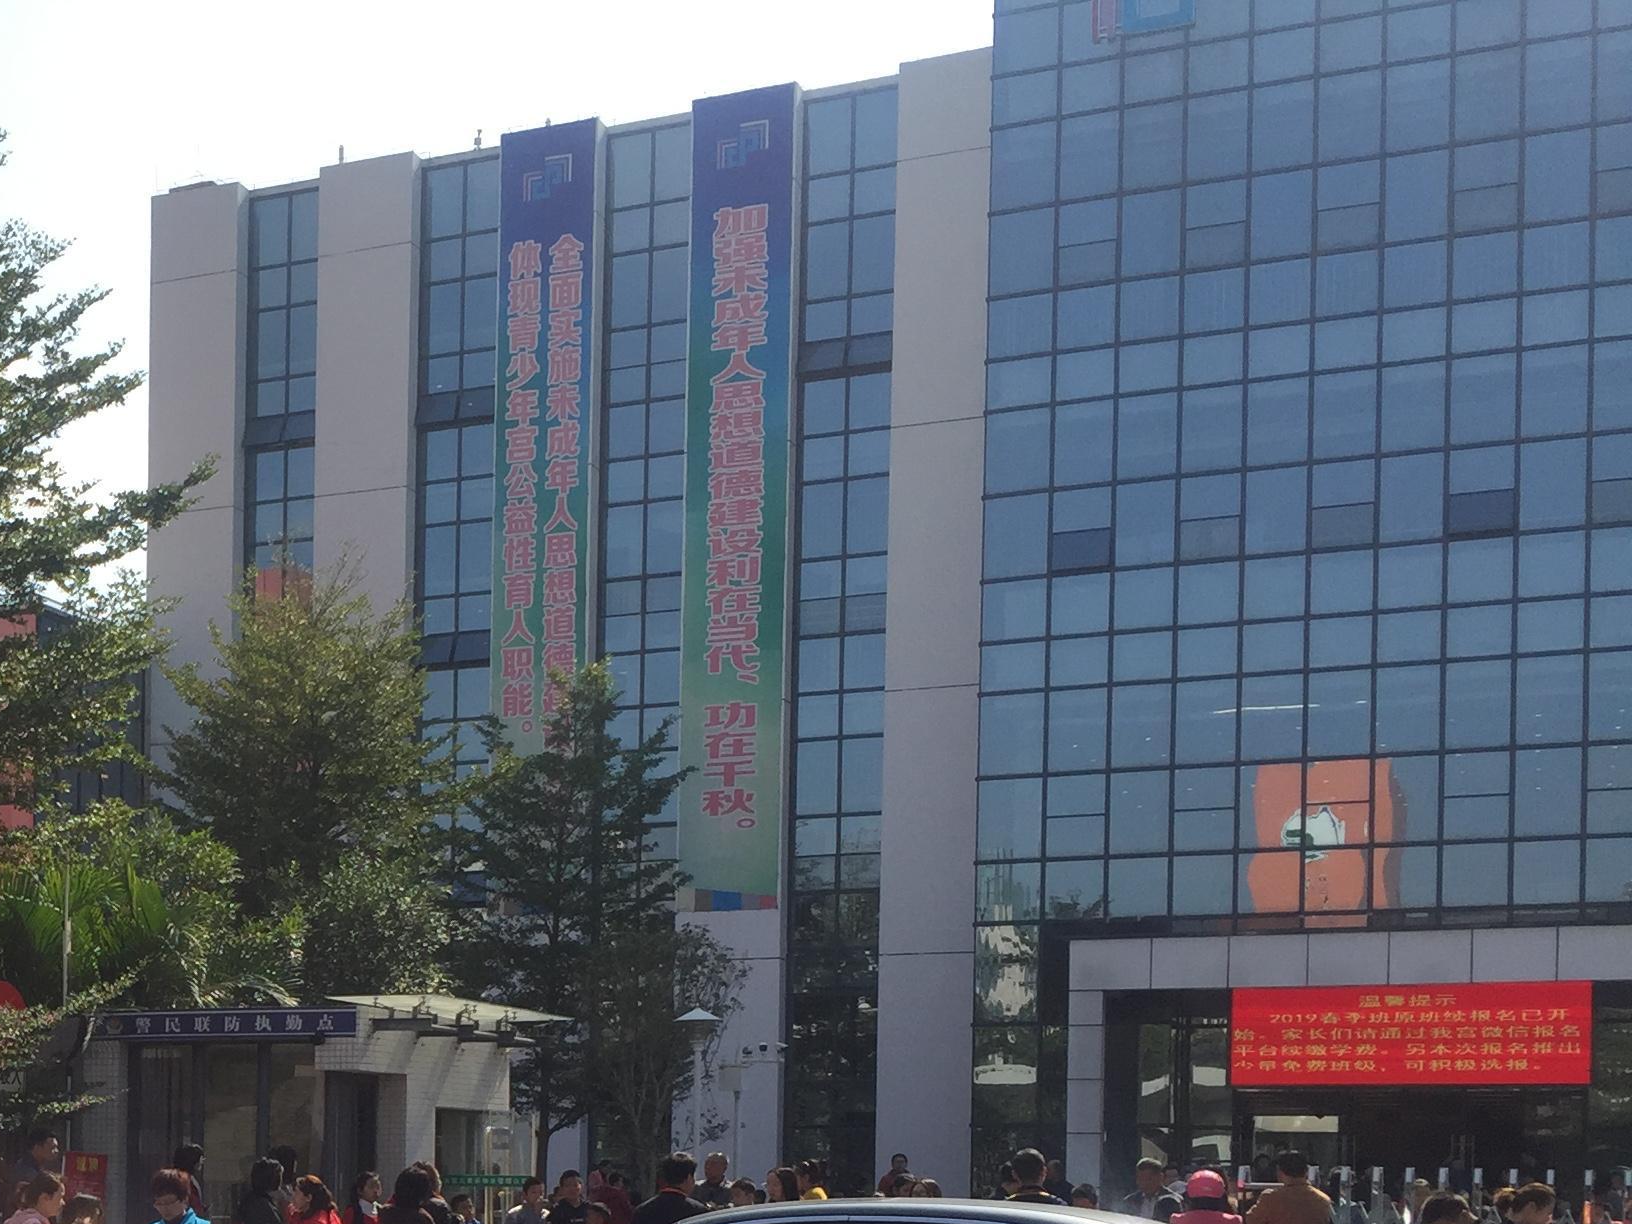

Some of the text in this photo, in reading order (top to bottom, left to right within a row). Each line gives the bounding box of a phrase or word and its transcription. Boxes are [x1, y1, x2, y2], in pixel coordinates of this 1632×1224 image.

[501, 240, 543, 734] 体现青少年宫公益性育人职能。
[542, 233, 585, 748] 全面实施未成年人思想道德建
[135, 1013, 336, 1034] 警民联防执勤点
[1358, 994, 1457, 1008] 温馨提示
